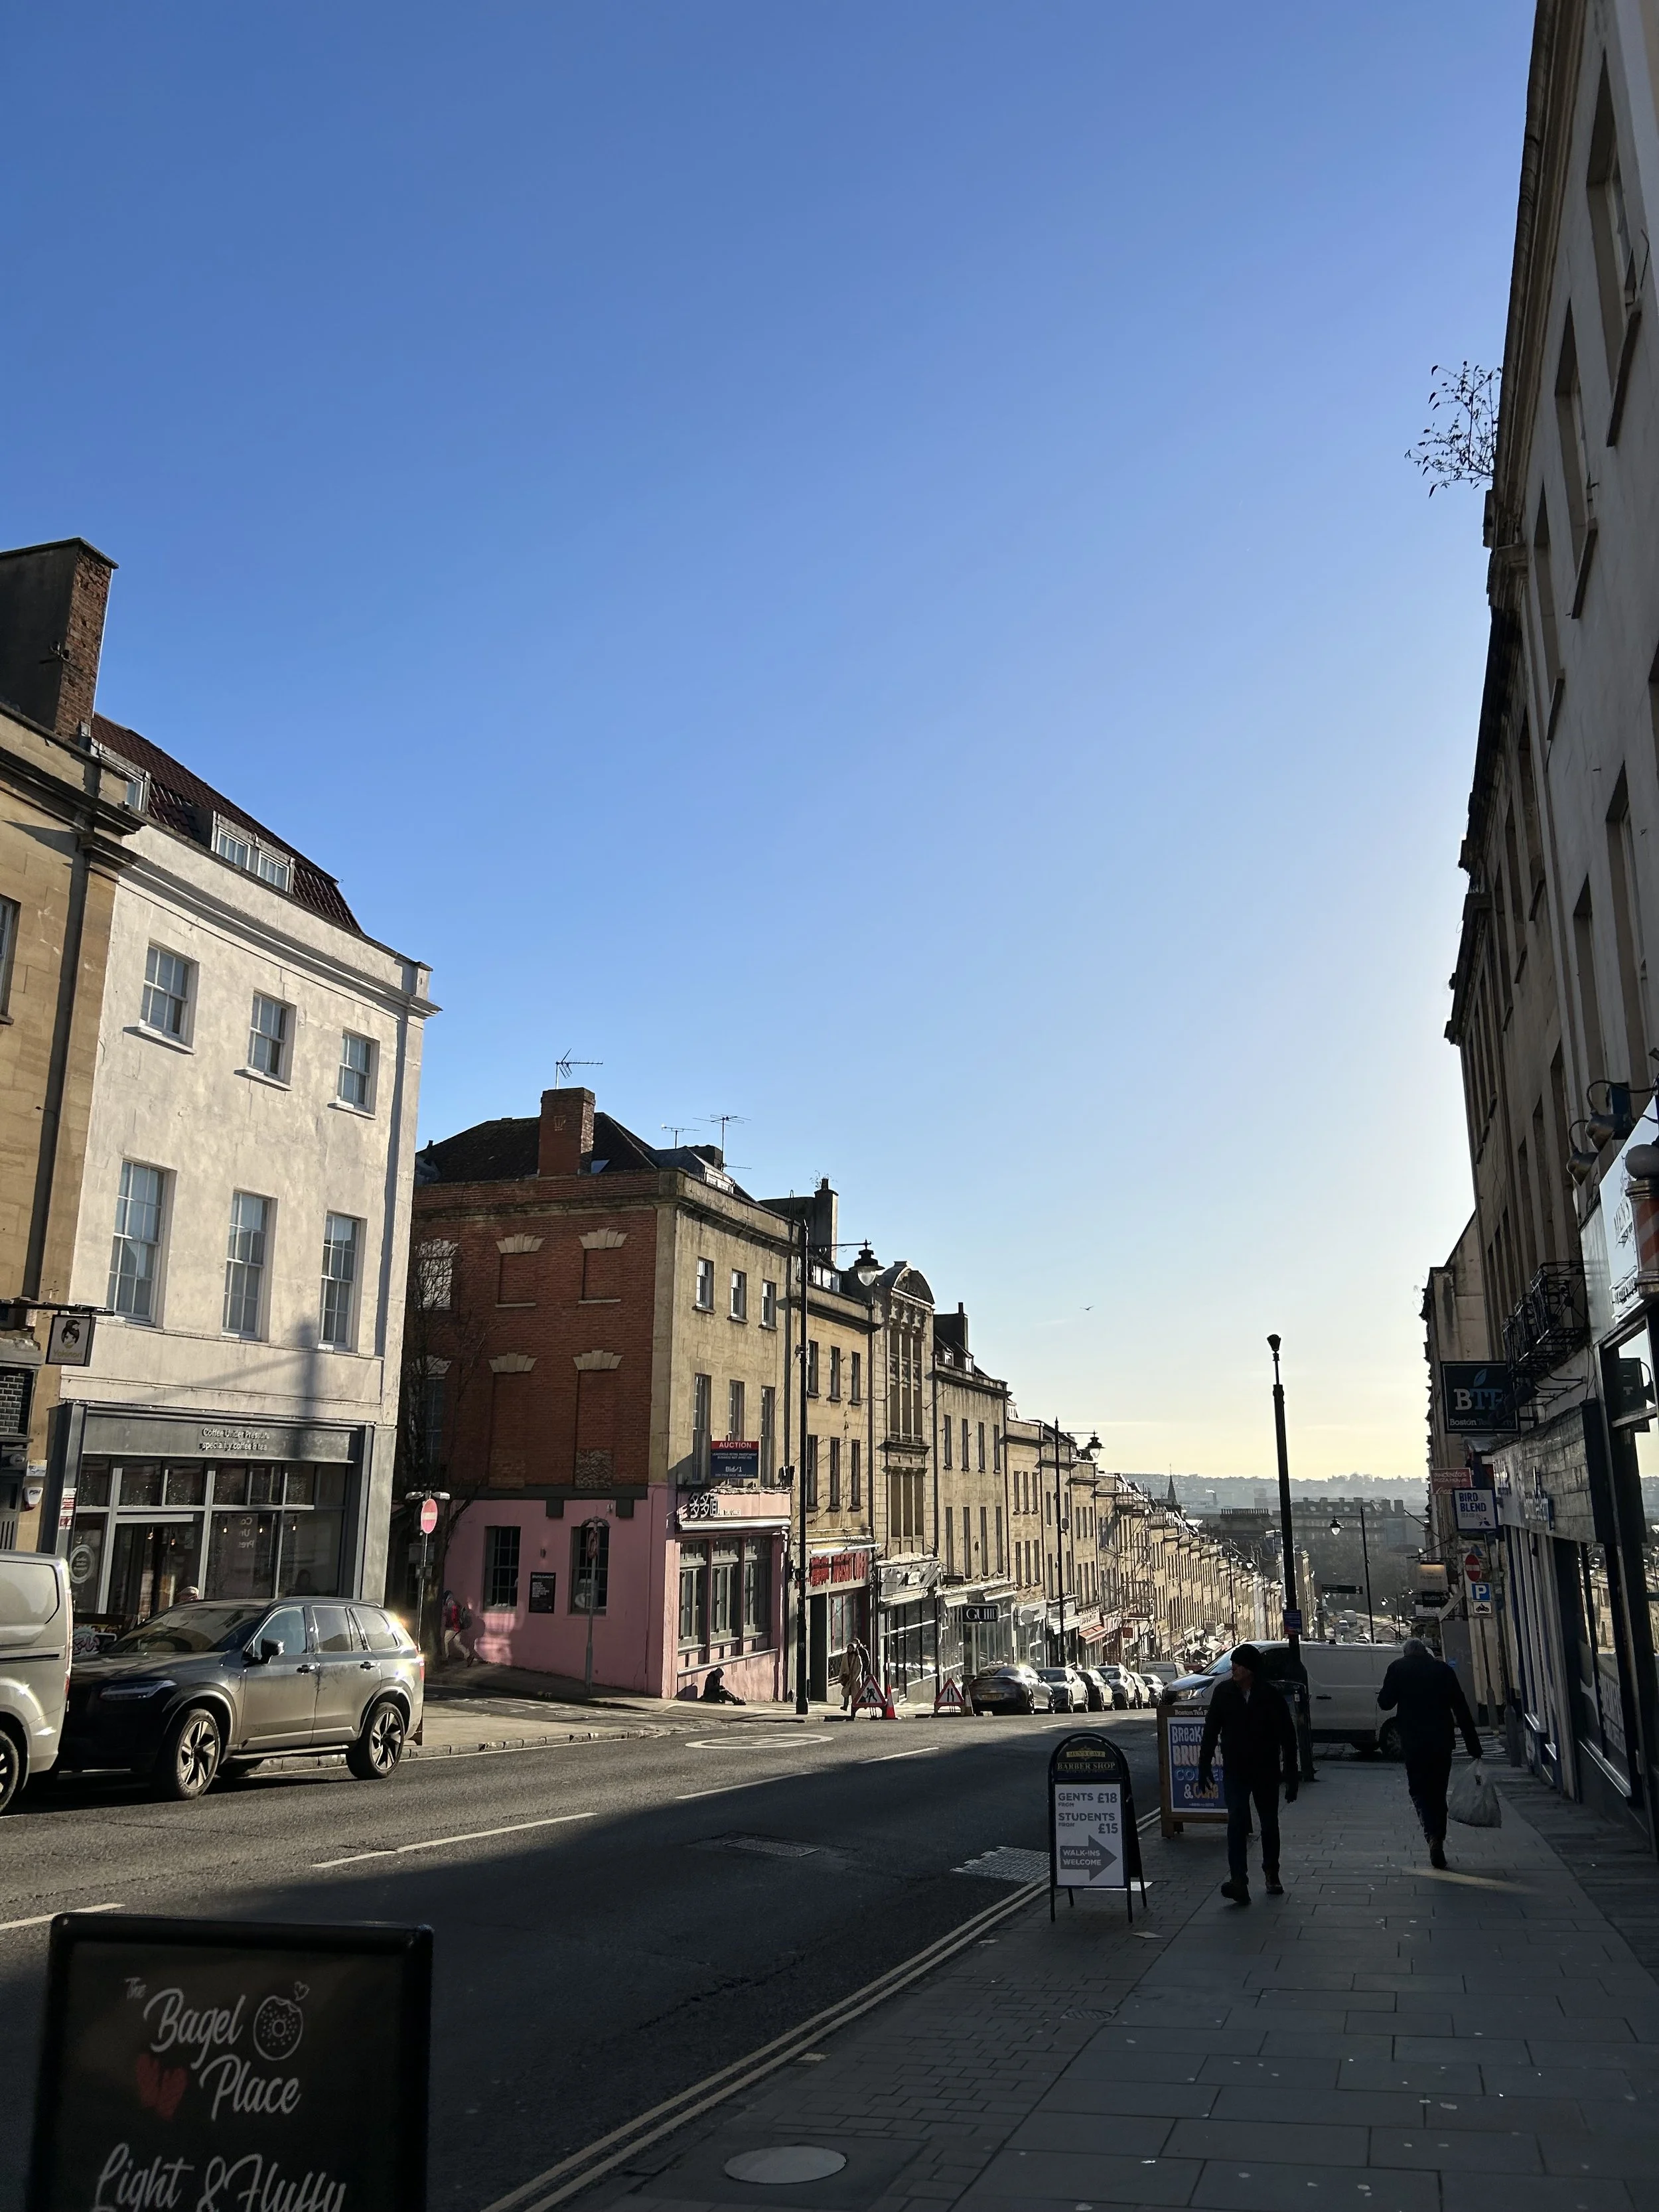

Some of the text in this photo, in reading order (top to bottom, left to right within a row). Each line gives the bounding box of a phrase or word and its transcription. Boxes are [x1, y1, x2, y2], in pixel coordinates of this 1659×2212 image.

[202, 1428, 224, 1437] Coffee
[1459, 1493, 1479, 1502] BIRD
[1460, 1503, 1486, 1512] BLEND
[1475, 1585, 1487, 1599] P
[1183, 1783, 1194, 1799] &
[1058, 1793, 1118, 1803] GENTS £18
[1058, 1812, 1116, 1821] STUDENTS
[1098, 1823, 1118, 1834] £15
[143, 1988, 246, 2070] Bagel
[200, 2053, 301, 2122] Place
[91, 2142, 348, 2212] Light & Fluffy
